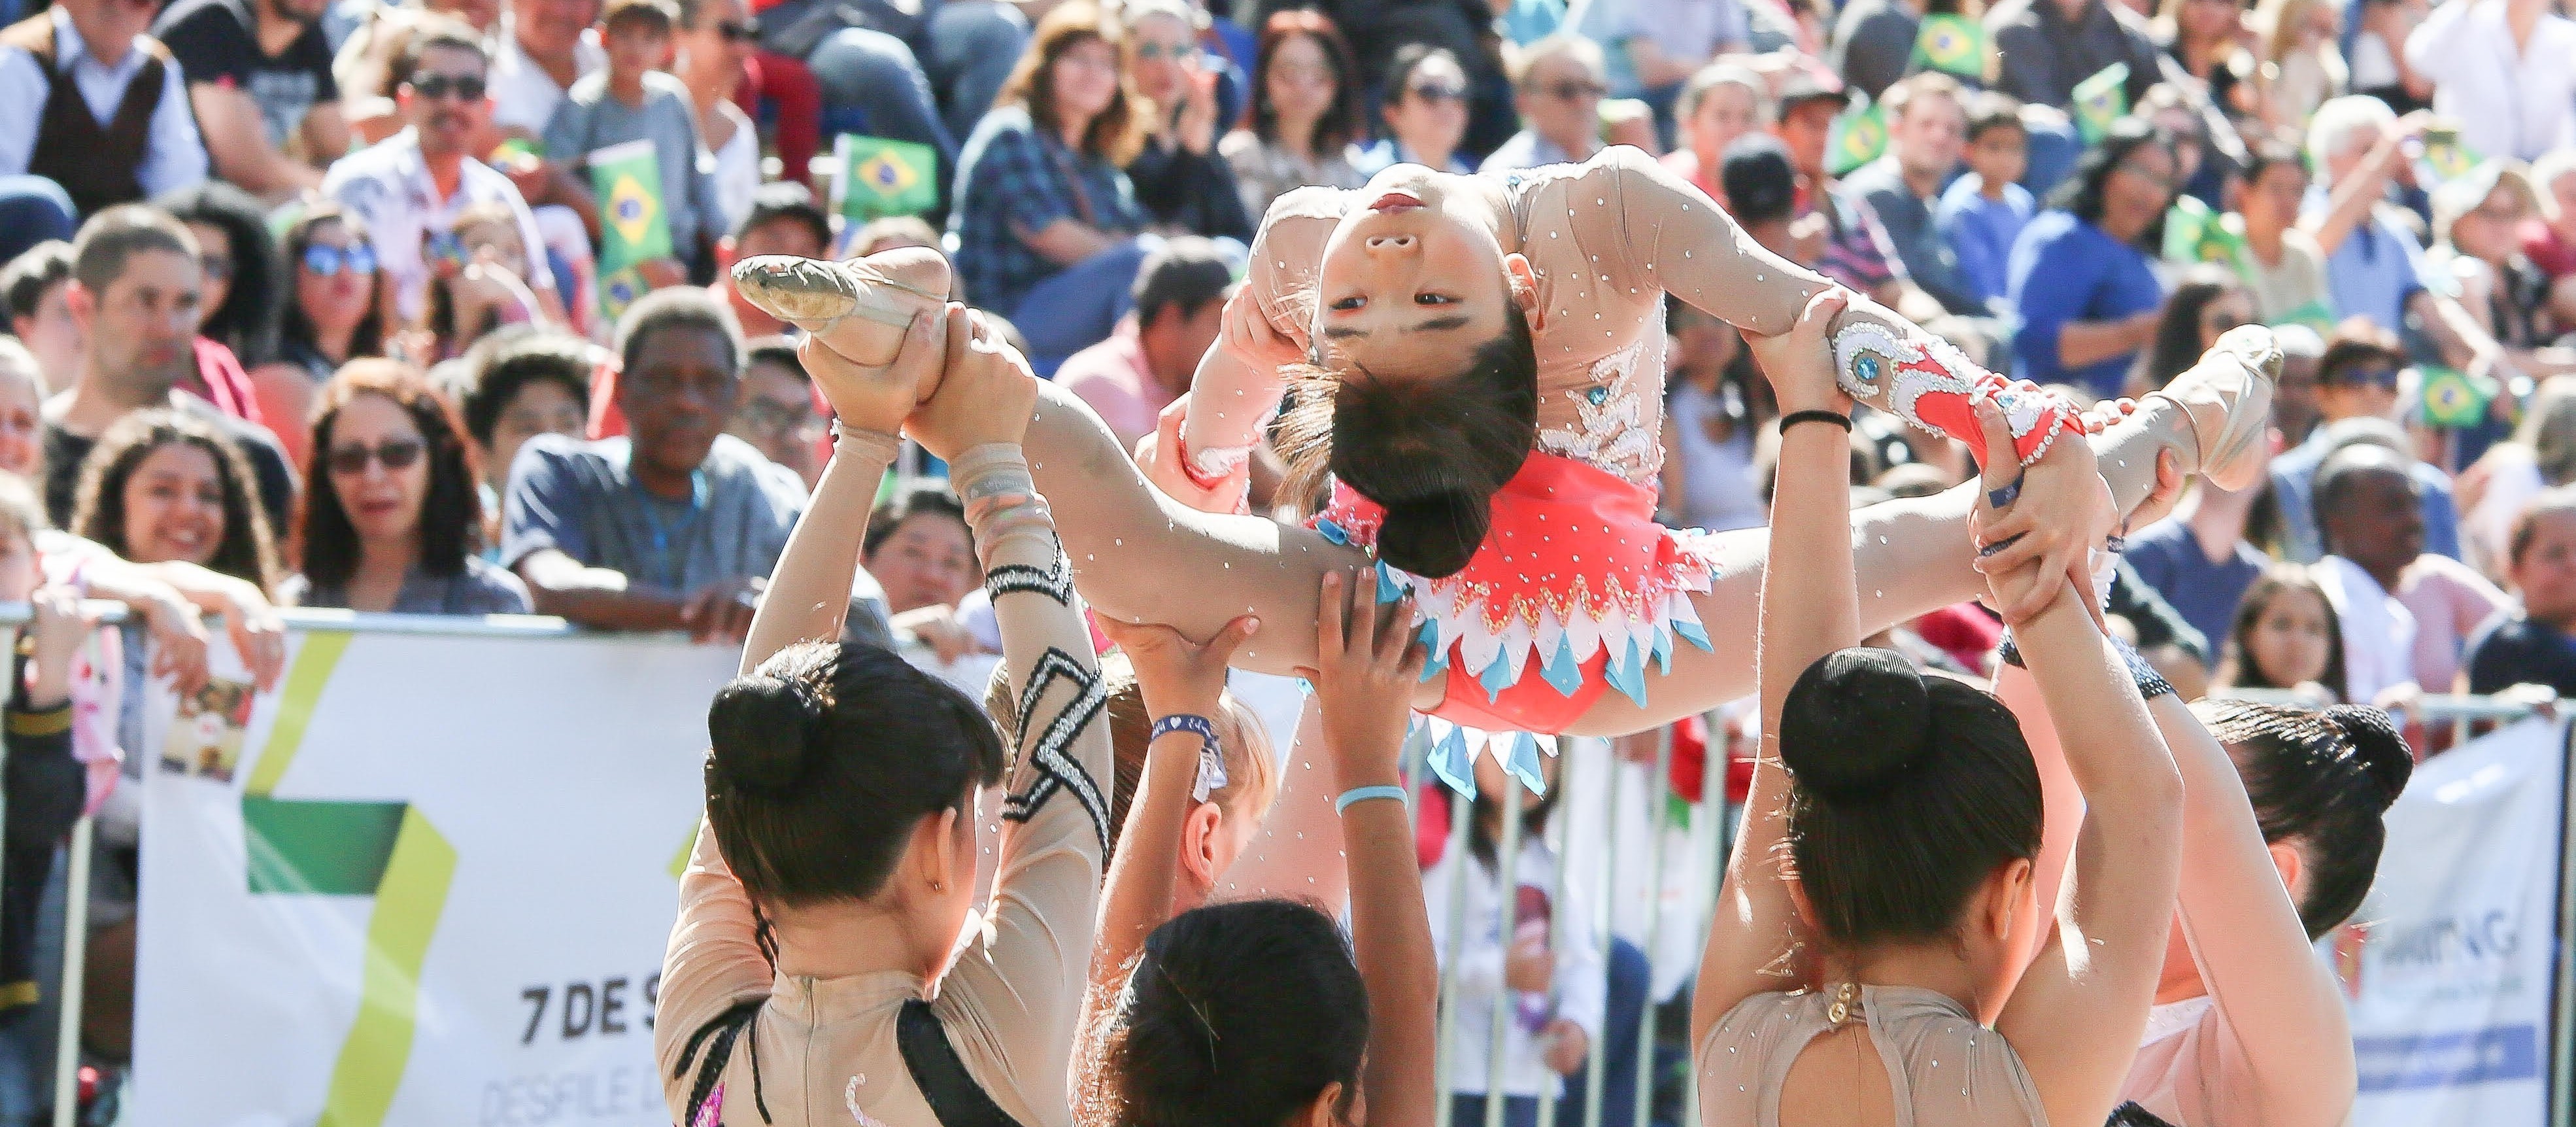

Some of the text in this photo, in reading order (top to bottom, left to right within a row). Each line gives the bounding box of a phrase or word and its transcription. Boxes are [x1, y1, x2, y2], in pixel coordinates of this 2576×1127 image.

[520, 985, 550, 1045] 7
[561, 977, 629, 1040] DE
[479, 1066, 632, 1127] DESFILE
